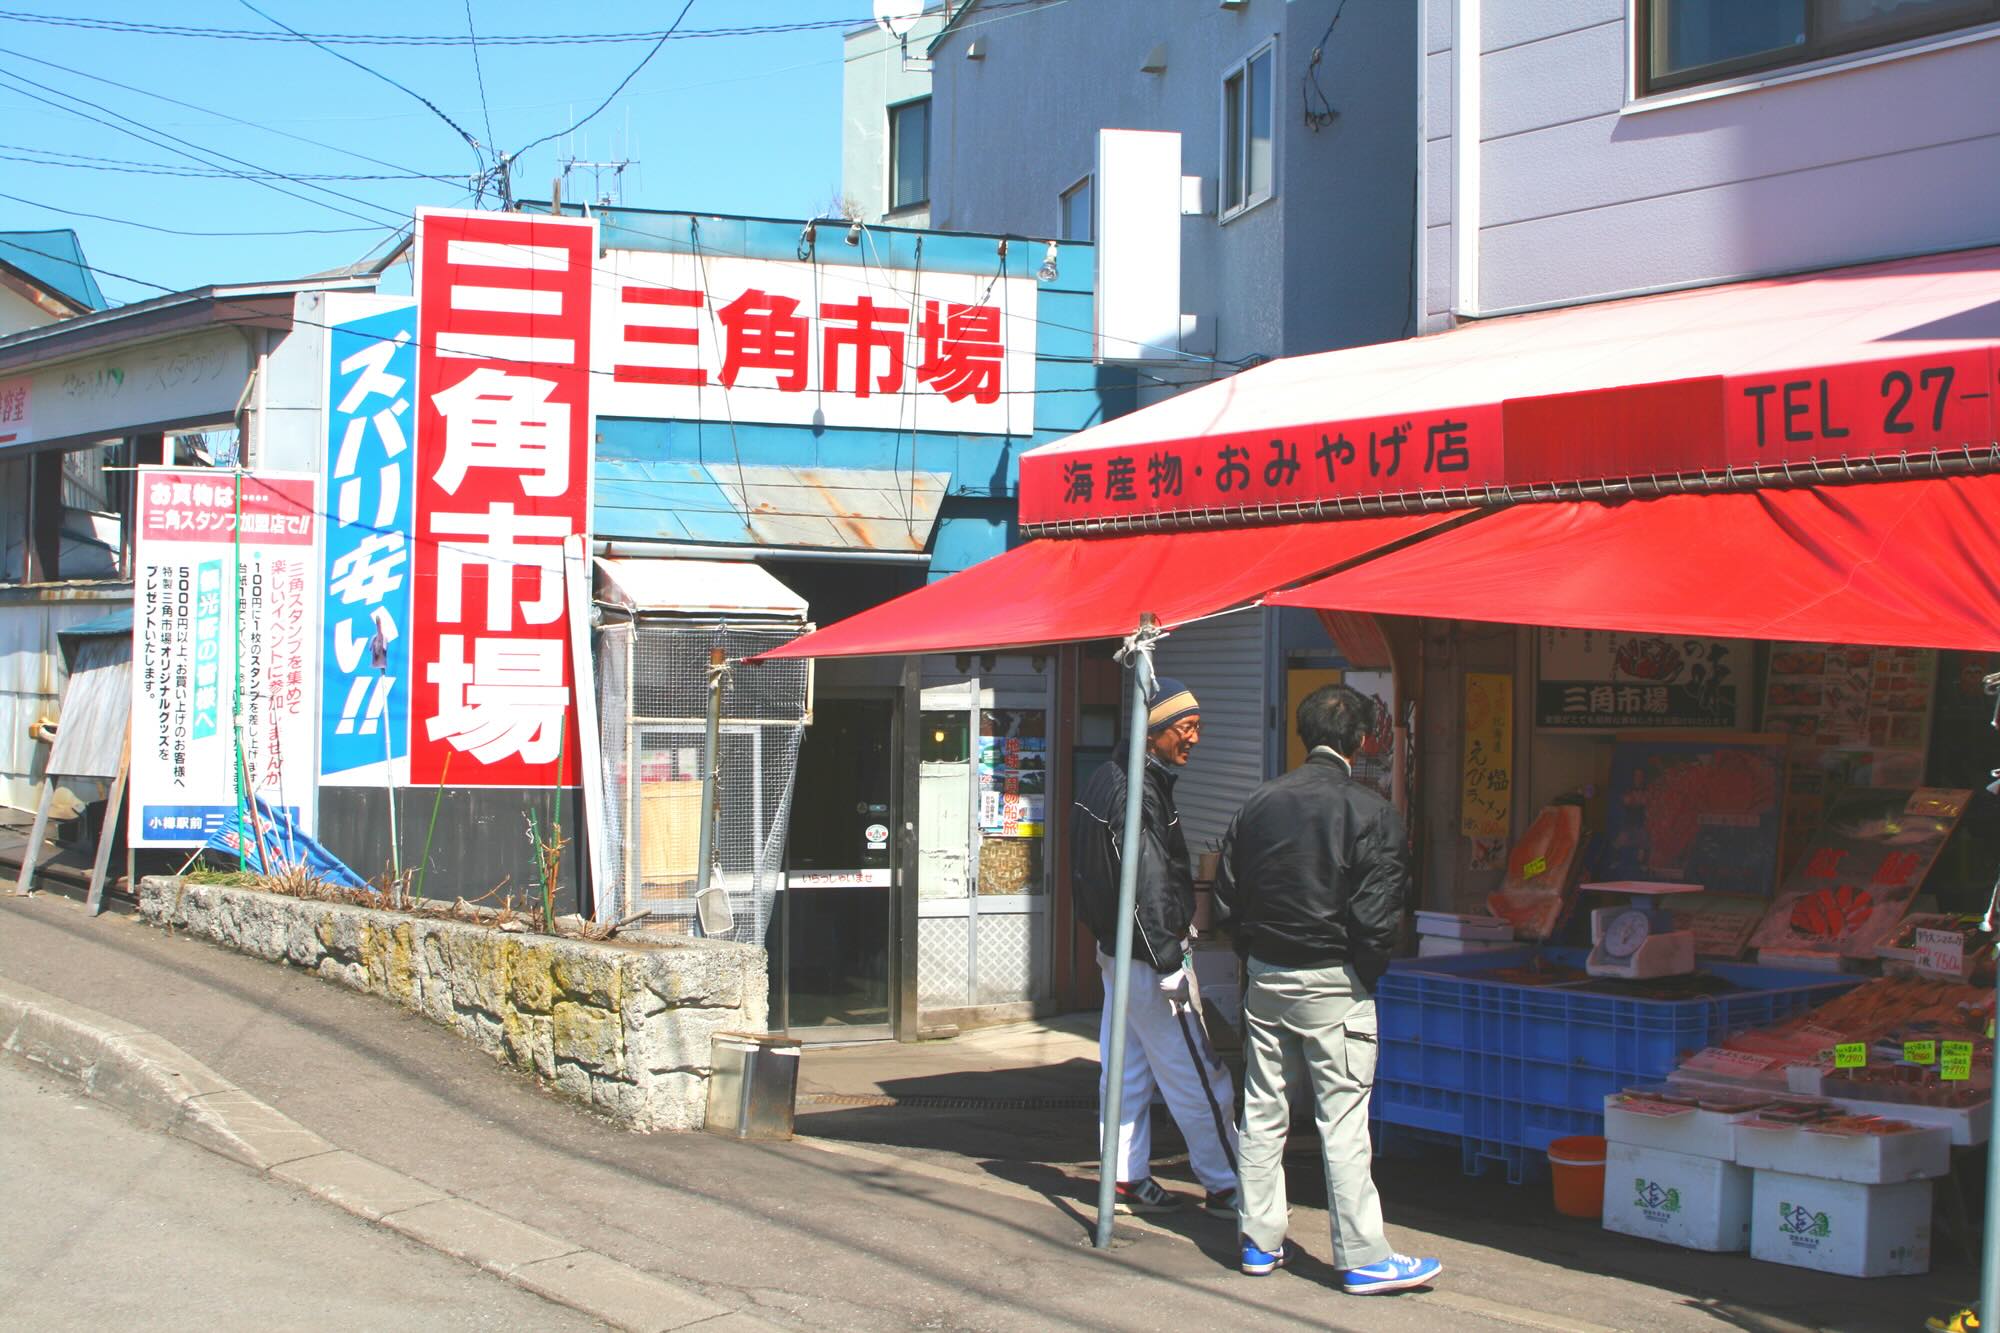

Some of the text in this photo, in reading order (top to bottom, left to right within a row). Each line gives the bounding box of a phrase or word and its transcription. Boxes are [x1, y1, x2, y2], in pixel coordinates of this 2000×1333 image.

[614, 286, 1005, 404] 三角市場
[1744, 366, 2000, 447] TEL 27-
[1064, 419, 1469, 503] 海産物・おみやげ店
[426, 241, 575, 765] 三角市場
[1563, 686, 1670, 714] 三角市場
[802, 871, 873, 884] いらっしゃいませ
